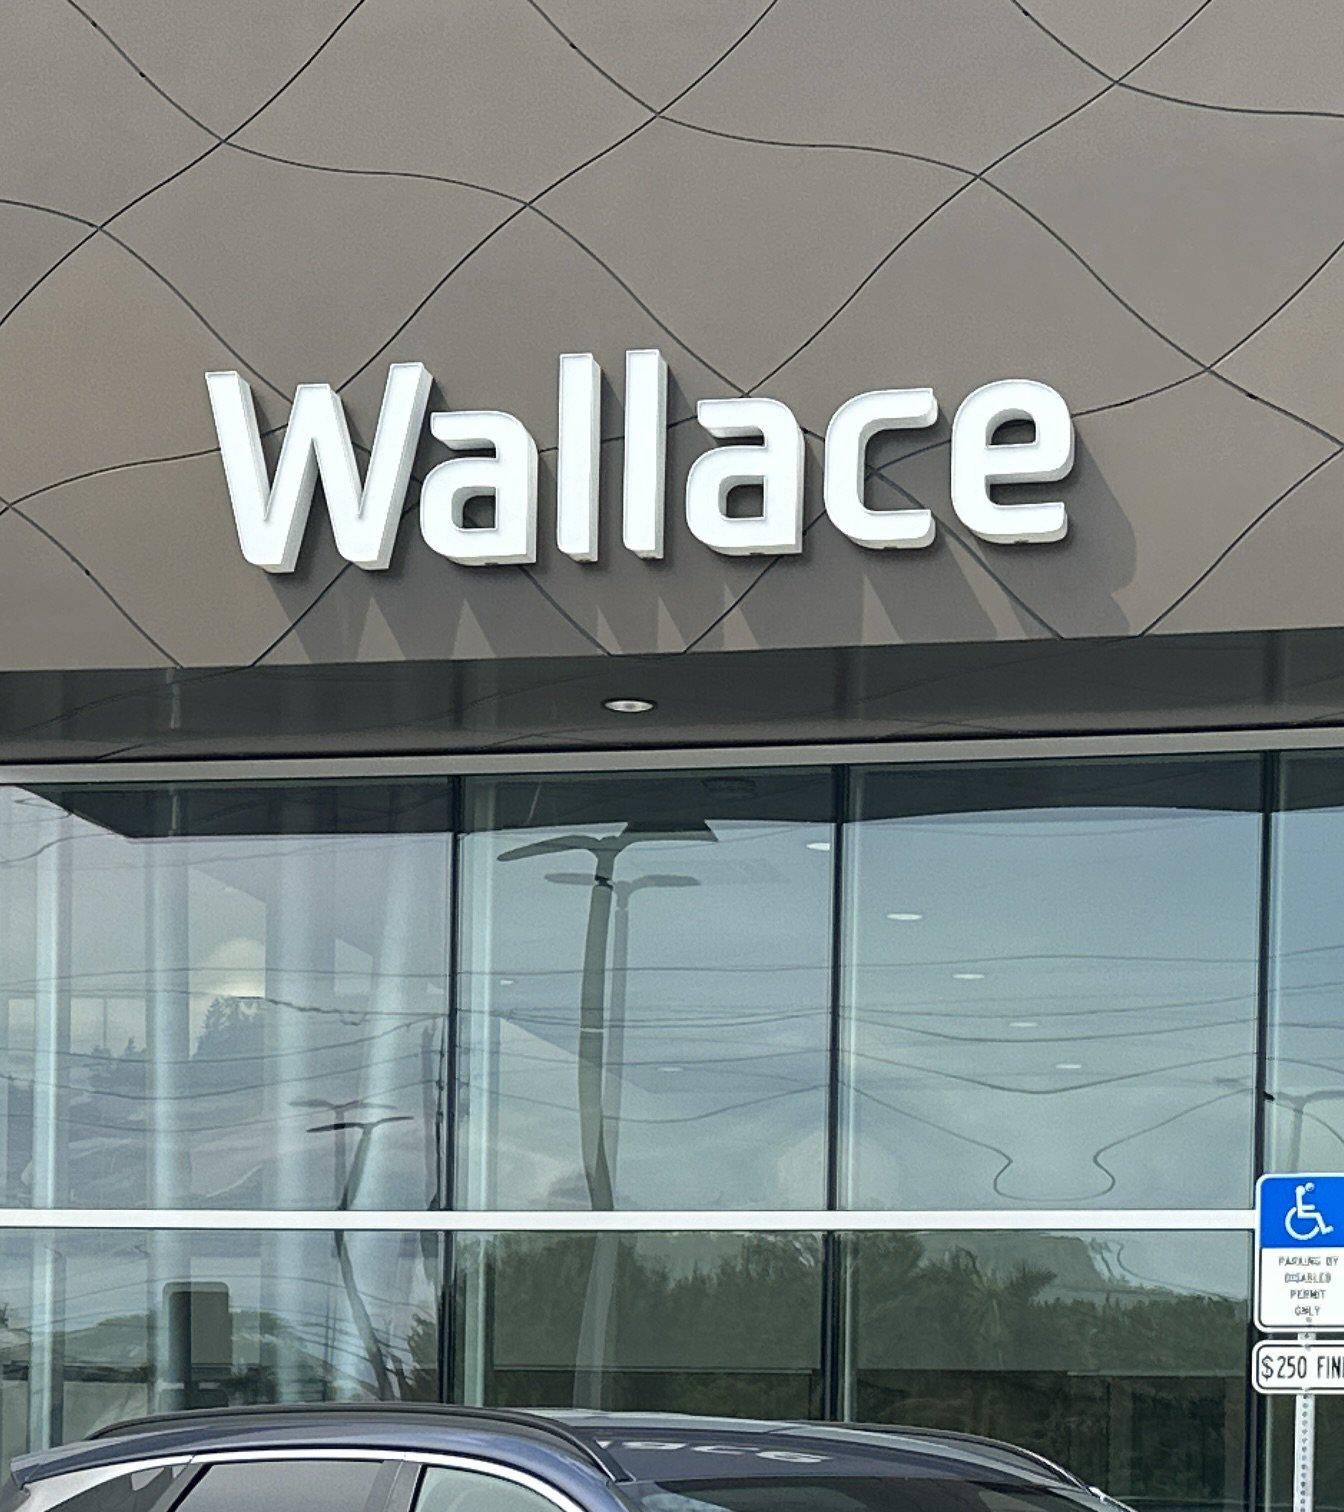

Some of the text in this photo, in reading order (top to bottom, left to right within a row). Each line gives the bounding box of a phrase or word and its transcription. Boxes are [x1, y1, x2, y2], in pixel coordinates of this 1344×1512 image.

[204, 349, 1077, 574] Wallace
[1278, 1256, 1339, 1266] PARKING BY
[1284, 1272, 1332, 1284] DISABLED
[1290, 1289, 1327, 1300] PERMIT
[1294, 1305, 1320, 1317] ONLY
[1261, 1354, 1308, 1383] $250
